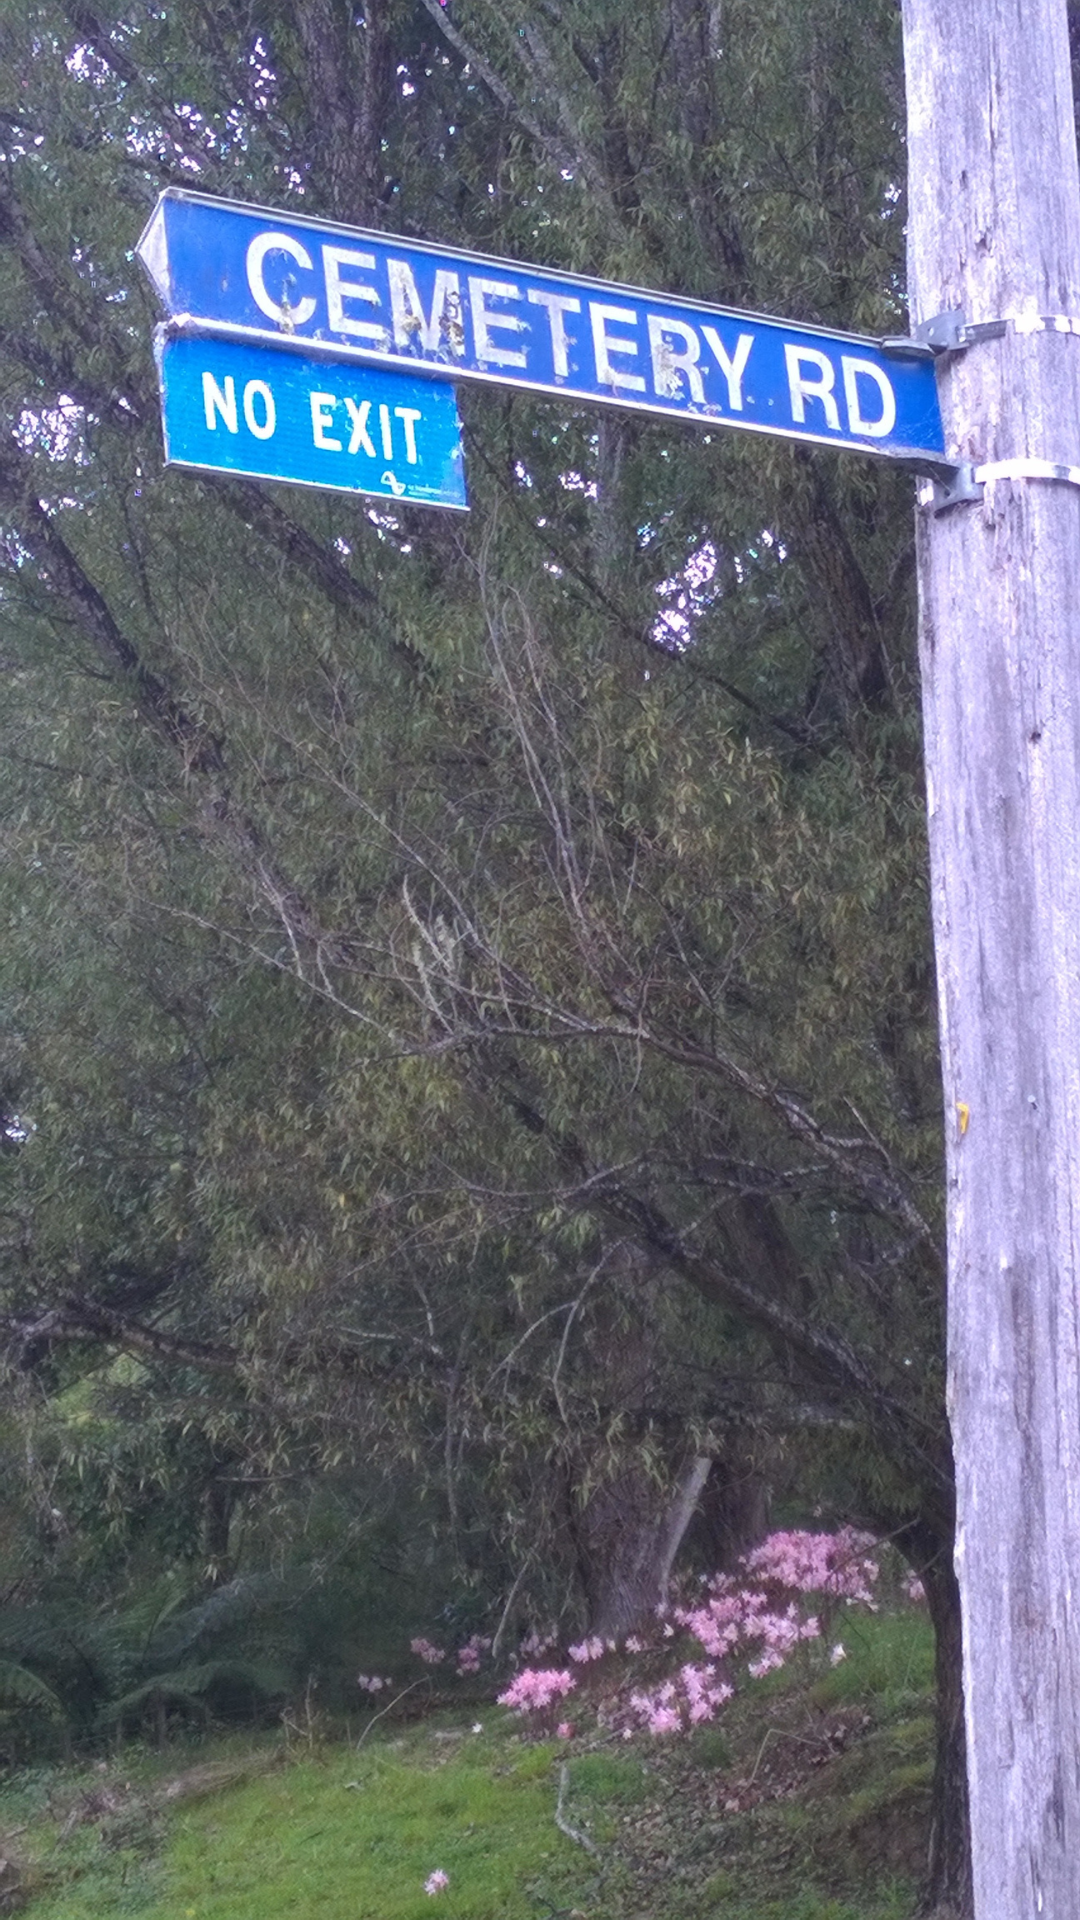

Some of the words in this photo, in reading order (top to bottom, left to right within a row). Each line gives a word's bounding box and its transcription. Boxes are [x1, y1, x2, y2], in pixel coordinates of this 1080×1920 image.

[246, 232, 754, 411] CEMETERY
[784, 344, 897, 438] RD
[202, 372, 276, 440] NO
[310, 392, 421, 465] EXIT
